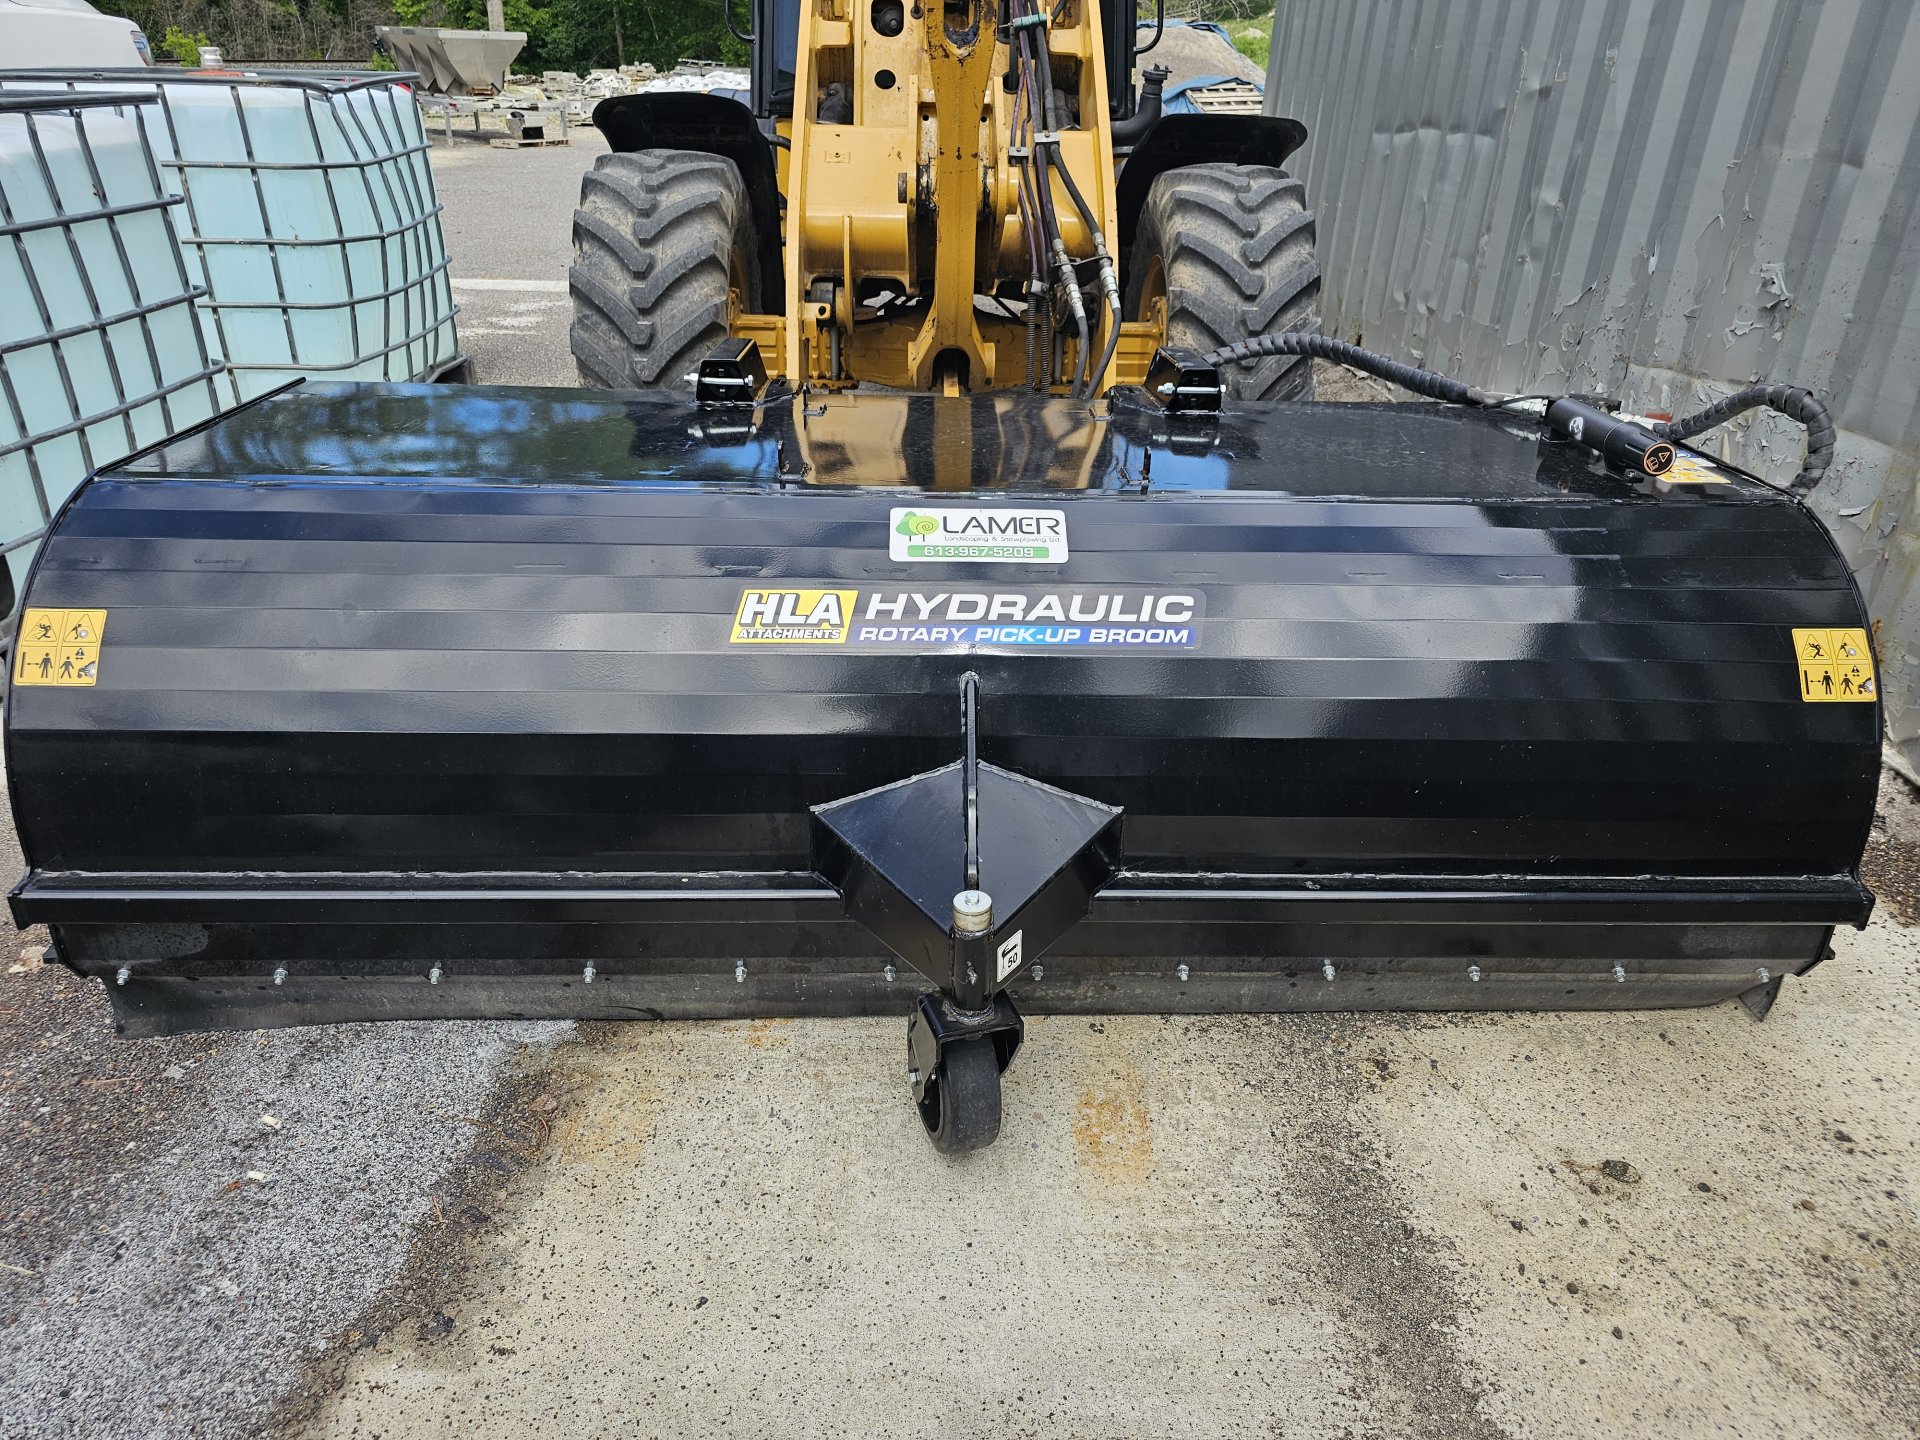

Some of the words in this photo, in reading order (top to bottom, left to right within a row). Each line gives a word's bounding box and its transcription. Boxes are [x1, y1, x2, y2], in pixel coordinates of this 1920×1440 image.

[943, 516, 1060, 535] LAMER
[924, 546, 1034, 558] 613-967-5209
[739, 593, 844, 628] HLA
[865, 593, 1195, 622] HYDRAULIC
[737, 628, 841, 640] ATTACHMENTS
[859, 627, 969, 642] ROTARY
[974, 627, 1081, 643] PICK-UP
[1088, 628, 1190, 643] BROOM
[1007, 952, 1018, 968] 50
